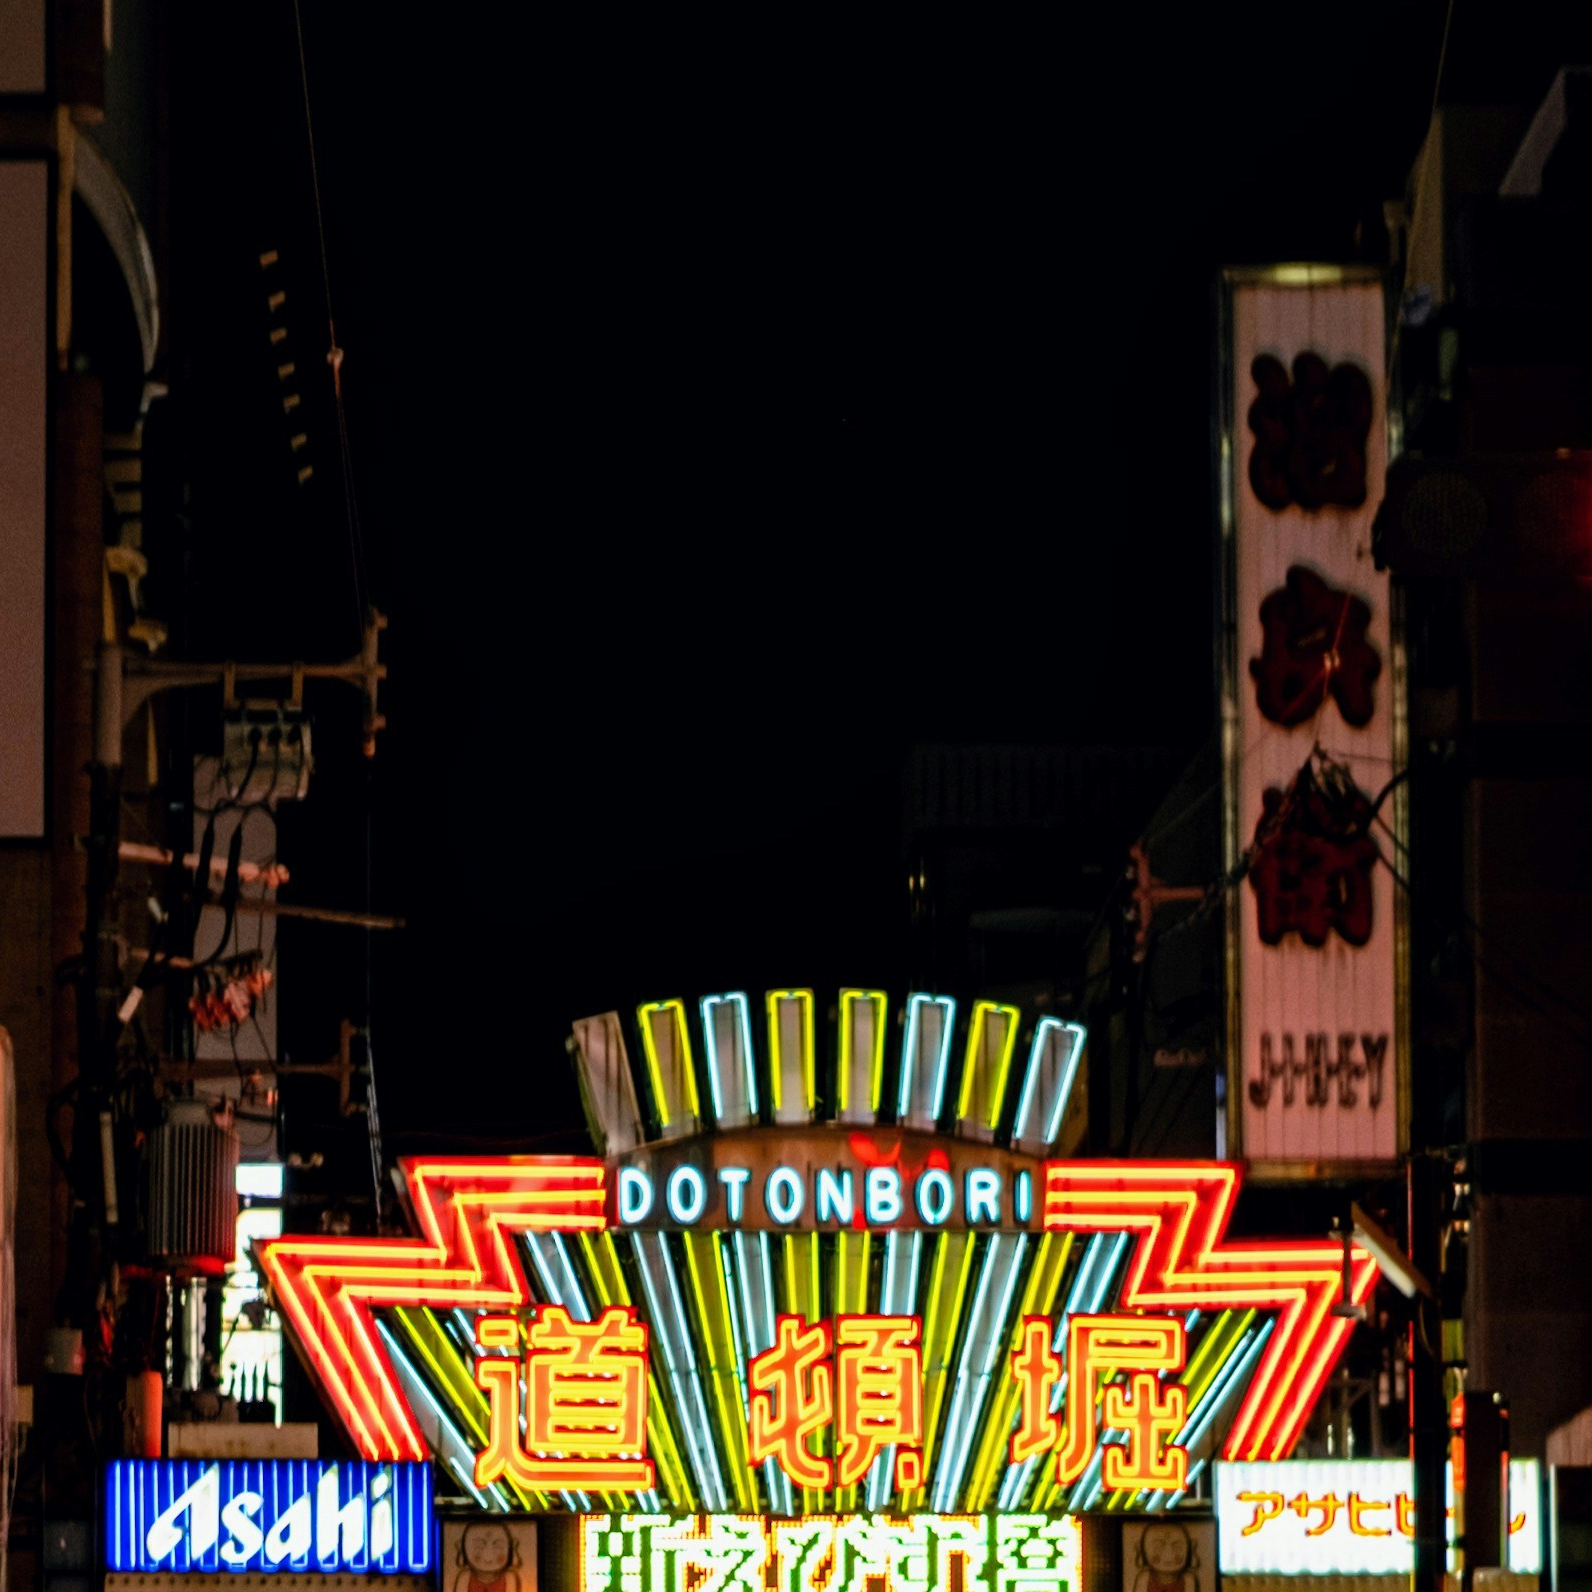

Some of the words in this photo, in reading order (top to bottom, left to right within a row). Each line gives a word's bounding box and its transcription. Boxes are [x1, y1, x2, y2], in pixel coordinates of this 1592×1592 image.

[617, 1165, 1033, 1226] DOTONBORI
[475, 1305, 1189, 1493] 道頓堀
[146, 1464, 395, 1564] Asahi
